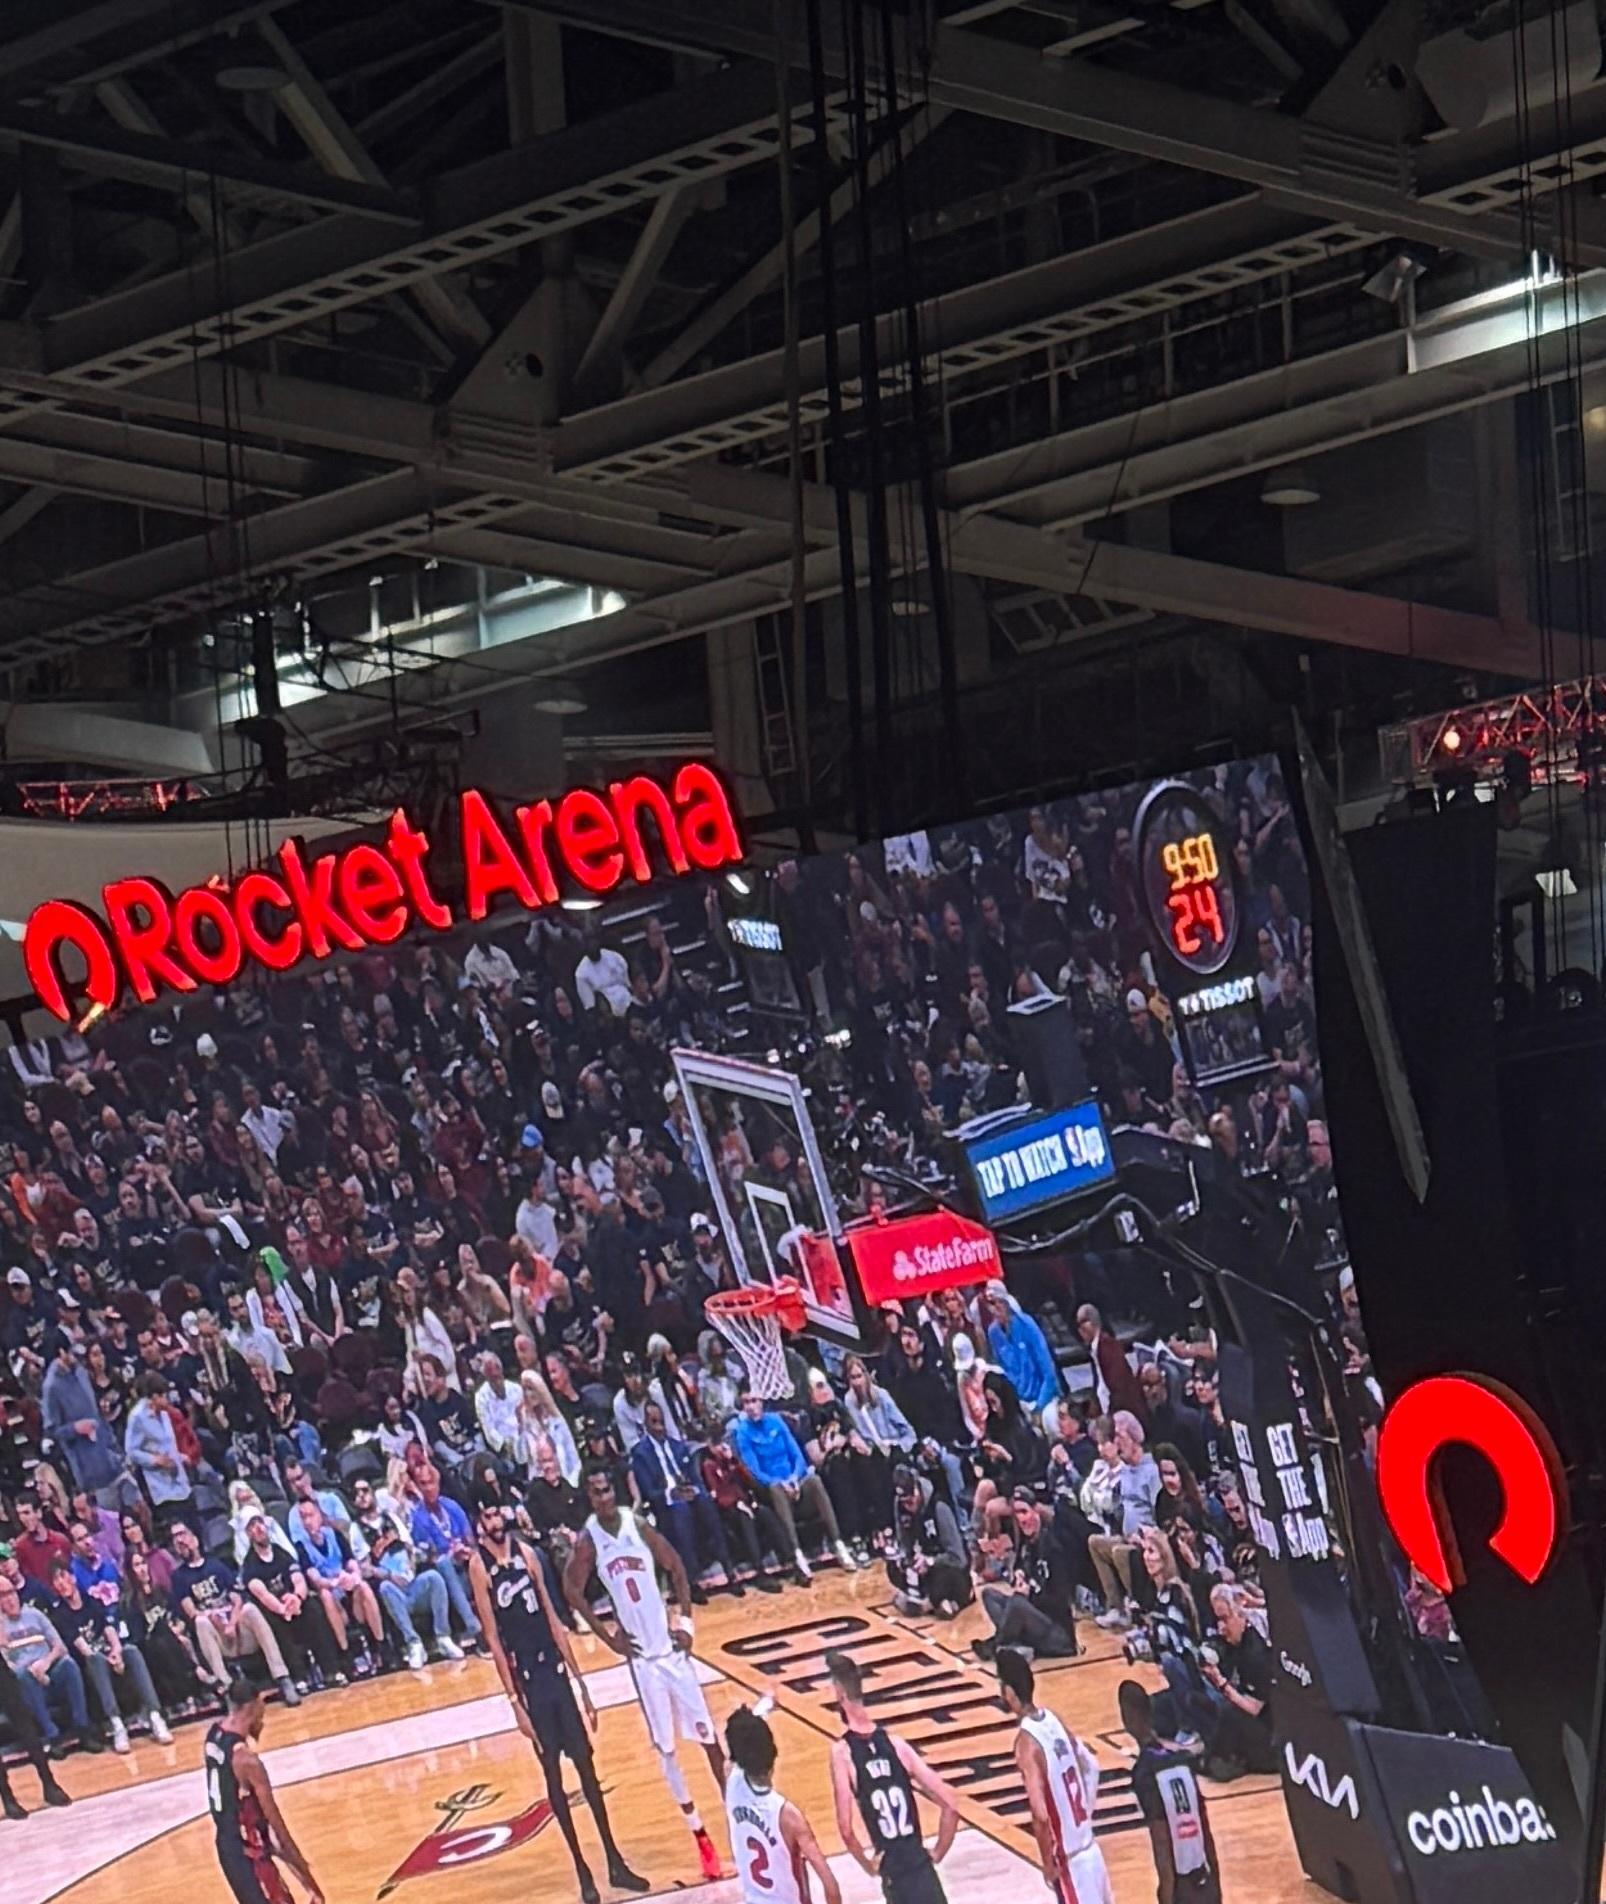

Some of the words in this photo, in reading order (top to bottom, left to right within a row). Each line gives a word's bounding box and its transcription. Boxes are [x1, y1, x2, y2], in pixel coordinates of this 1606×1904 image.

[103, 807, 452, 1001] Rocket
[461, 762, 743, 919] Arena
[1168, 885, 1224, 954] 24
[1201, 977, 1256, 1013] TISSOT
[870, 1785, 914, 1840] 32
[1408, 1790, 1556, 1856] coinba
[746, 1835, 774, 1890] 2
